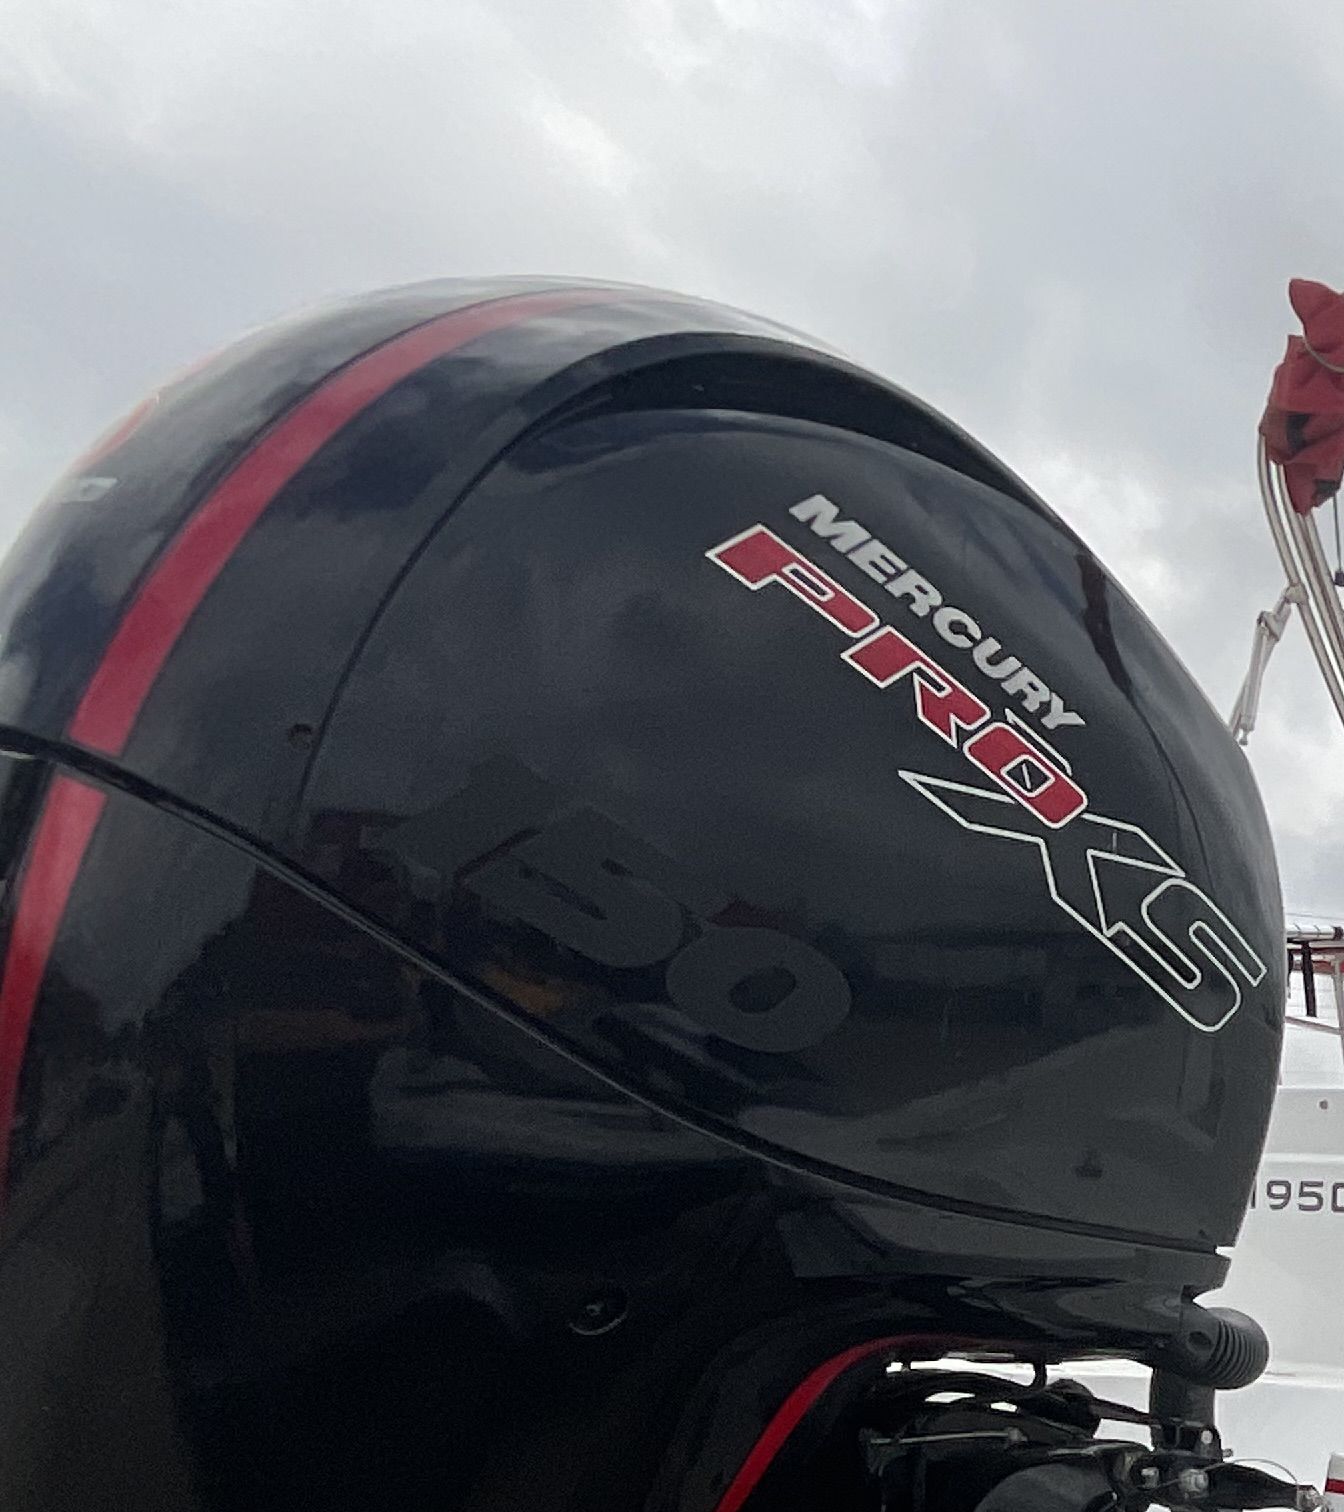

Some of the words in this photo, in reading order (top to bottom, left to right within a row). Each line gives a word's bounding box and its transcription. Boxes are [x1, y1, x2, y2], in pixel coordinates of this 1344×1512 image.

[705, 523, 1088, 829] PRO
[899, 707, 1267, 1032] XS
[789, 494, 1085, 732] MERCURY
